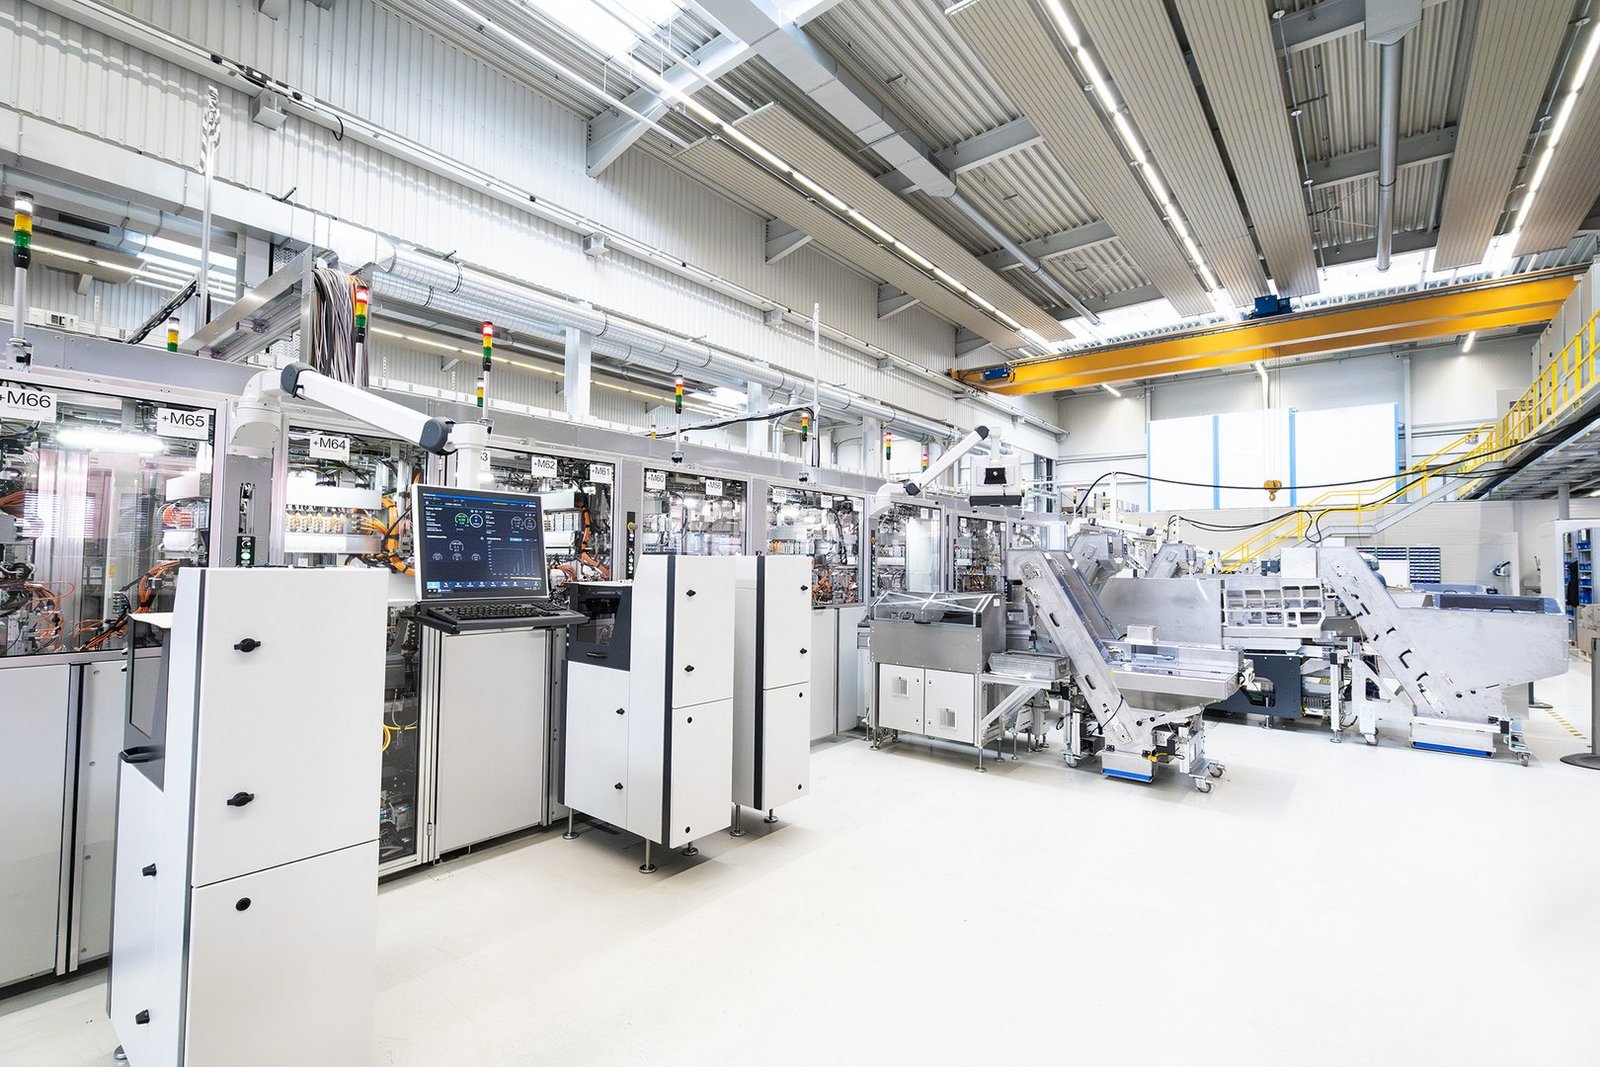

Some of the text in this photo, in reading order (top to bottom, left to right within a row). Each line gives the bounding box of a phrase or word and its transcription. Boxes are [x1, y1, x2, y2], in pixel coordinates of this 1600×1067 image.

[162, 412, 205, 427] +M65
[313, 437, 346, 450] +M64
[534, 459, 556, 470] +M62
[592, 466, 610, 476] +M61
